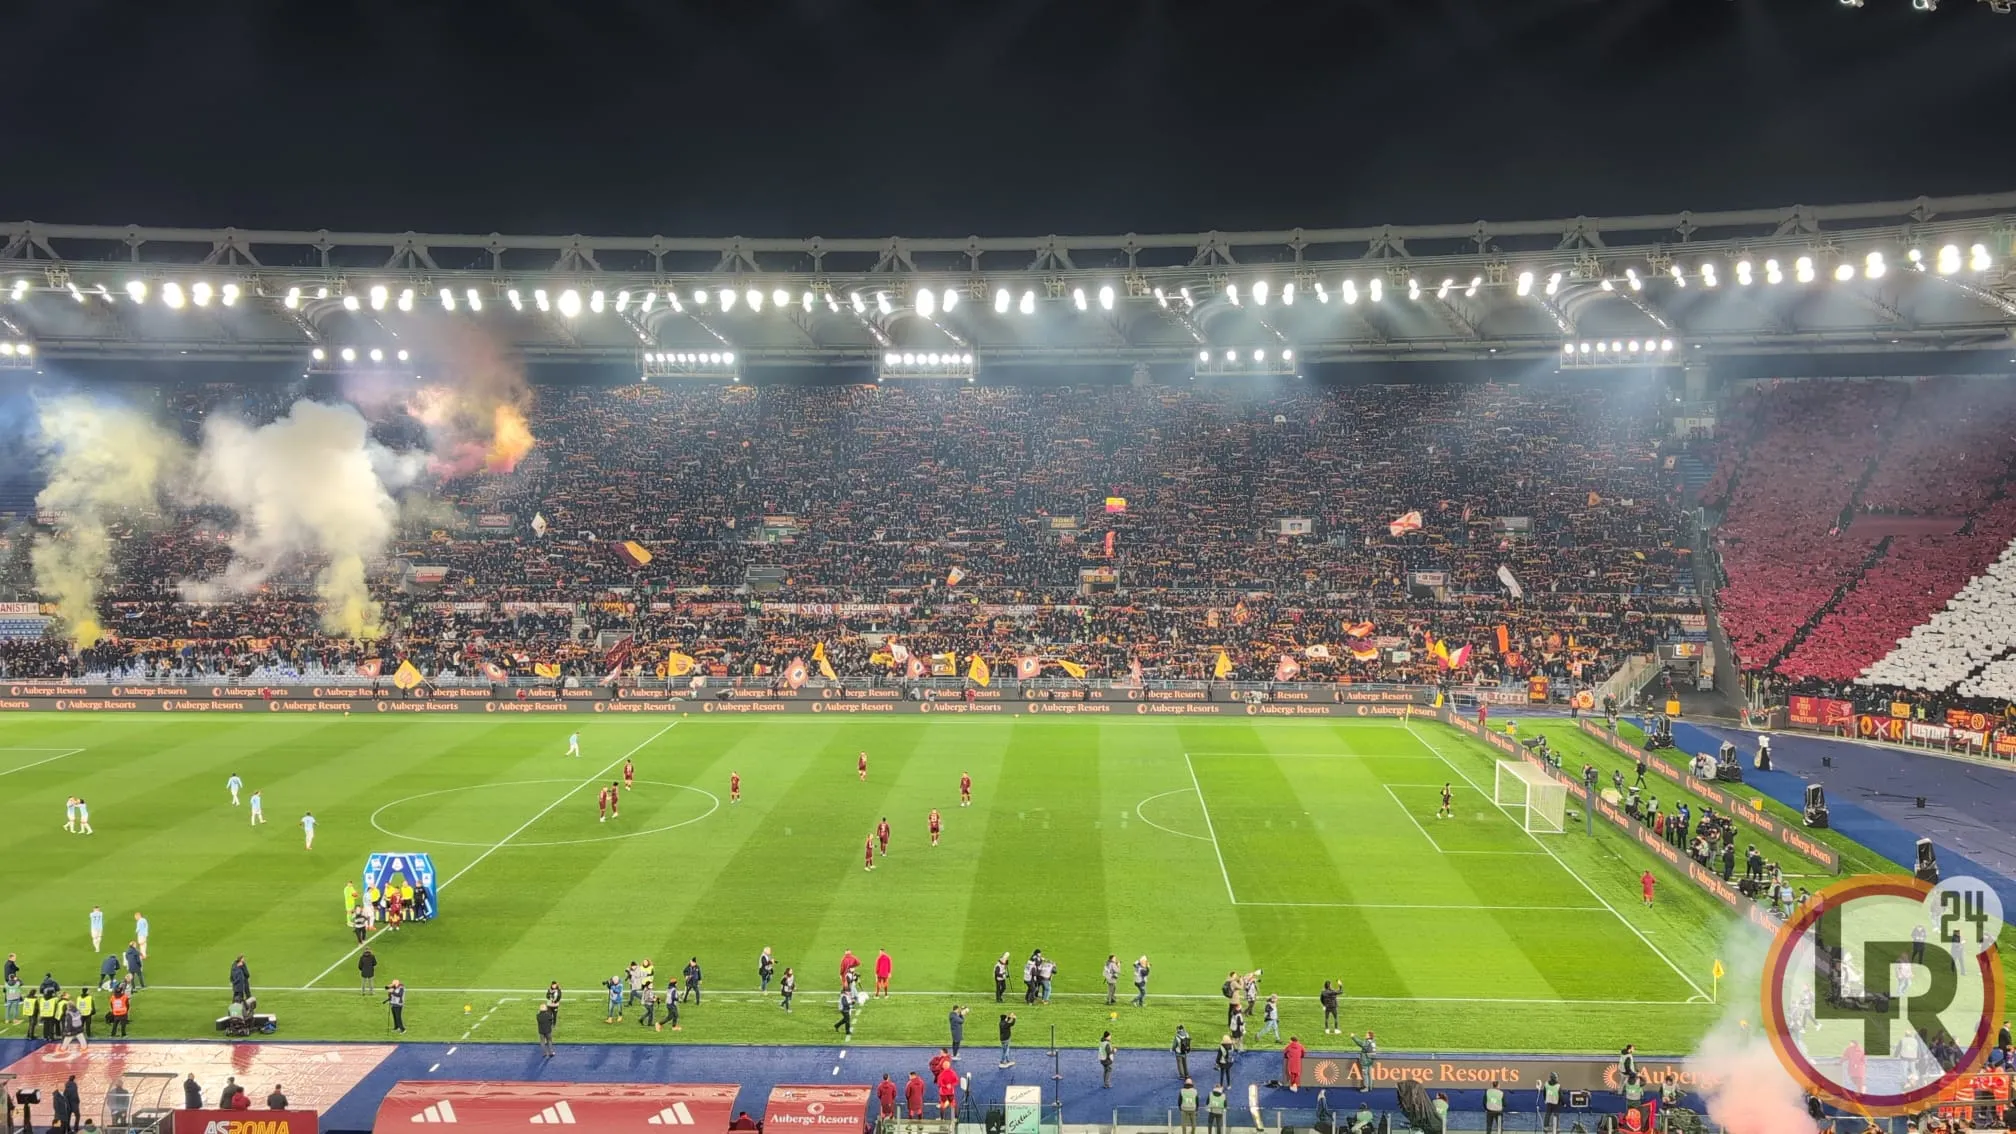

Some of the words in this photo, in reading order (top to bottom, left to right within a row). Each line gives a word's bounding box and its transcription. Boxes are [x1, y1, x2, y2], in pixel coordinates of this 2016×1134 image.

[800, 603, 833, 615] SPQR
[840, 603, 881, 611] LUCANIA
[23, 687, 55, 696] Auberge
[57, 687, 87, 695] Resorts
[124, 687, 156, 697] Auberge
[158, 687, 187, 695] Resorts
[224, 688, 257, 697] Auberge
[258, 688, 288, 696] Rorts
[325, 688, 357, 697] Auberge
[359, 688, 388, 696] Resrts
[461, 688, 490, 696] Resorts
[528, 688, 561, 698] Auberg
[630, 688, 663, 698] Auberge
[767, 688, 797, 696] Rsorts
[835, 688, 867, 698] Aberge
[869, 689, 899, 697] Resorts
[970, 689, 1000, 697] esorts
[1038, 689, 1071, 699] Auerge
[1174, 690, 1204, 698] Resorts
[1277, 691, 1308, 699] Resorts
[1347, 692, 1381, 701] Auberge
[1383, 692, 1412, 700] Resorts
[69, 701, 102, 711] Auberge
[104, 701, 136, 710] Resorts
[175, 701, 209, 711] Auberge
[211, 702, 243, 710] Resorts
[283, 702, 317, 711] Auberge
[319, 702, 351, 710] Resorts
[390, 702, 424, 712] Auberge
[426, 702, 458, 711] Resorts
[499, 703, 533, 712] Auberge
[535, 703, 567, 711] Resorts
[607, 703, 641, 712] Auberge
[643, 703, 675, 712] Resorts
[716, 703, 750, 713] Auberge
[752, 703, 784, 712] Resorts
[825, 704, 859, 713] Auberge
[861, 704, 893, 712] Resorts
[933, 704, 967, 714] Auberge
[969, 704, 1001, 713] Resorts
[1041, 704, 1076, 714] Auberge
[1078, 705, 1110, 713] Resorts
[1150, 705, 1185, 714] Auberge
[1187, 705, 1219, 713] Resorts
[1259, 705, 1295, 715] Auberge
[1297, 705, 1329, 714] Resorts
[1370, 706, 1406, 715] Auberge
[1440, 1063, 1519, 1082] Resorts
[771, 1114, 815, 1126] Auberge
[818, 1115, 859, 1124] Resorts
